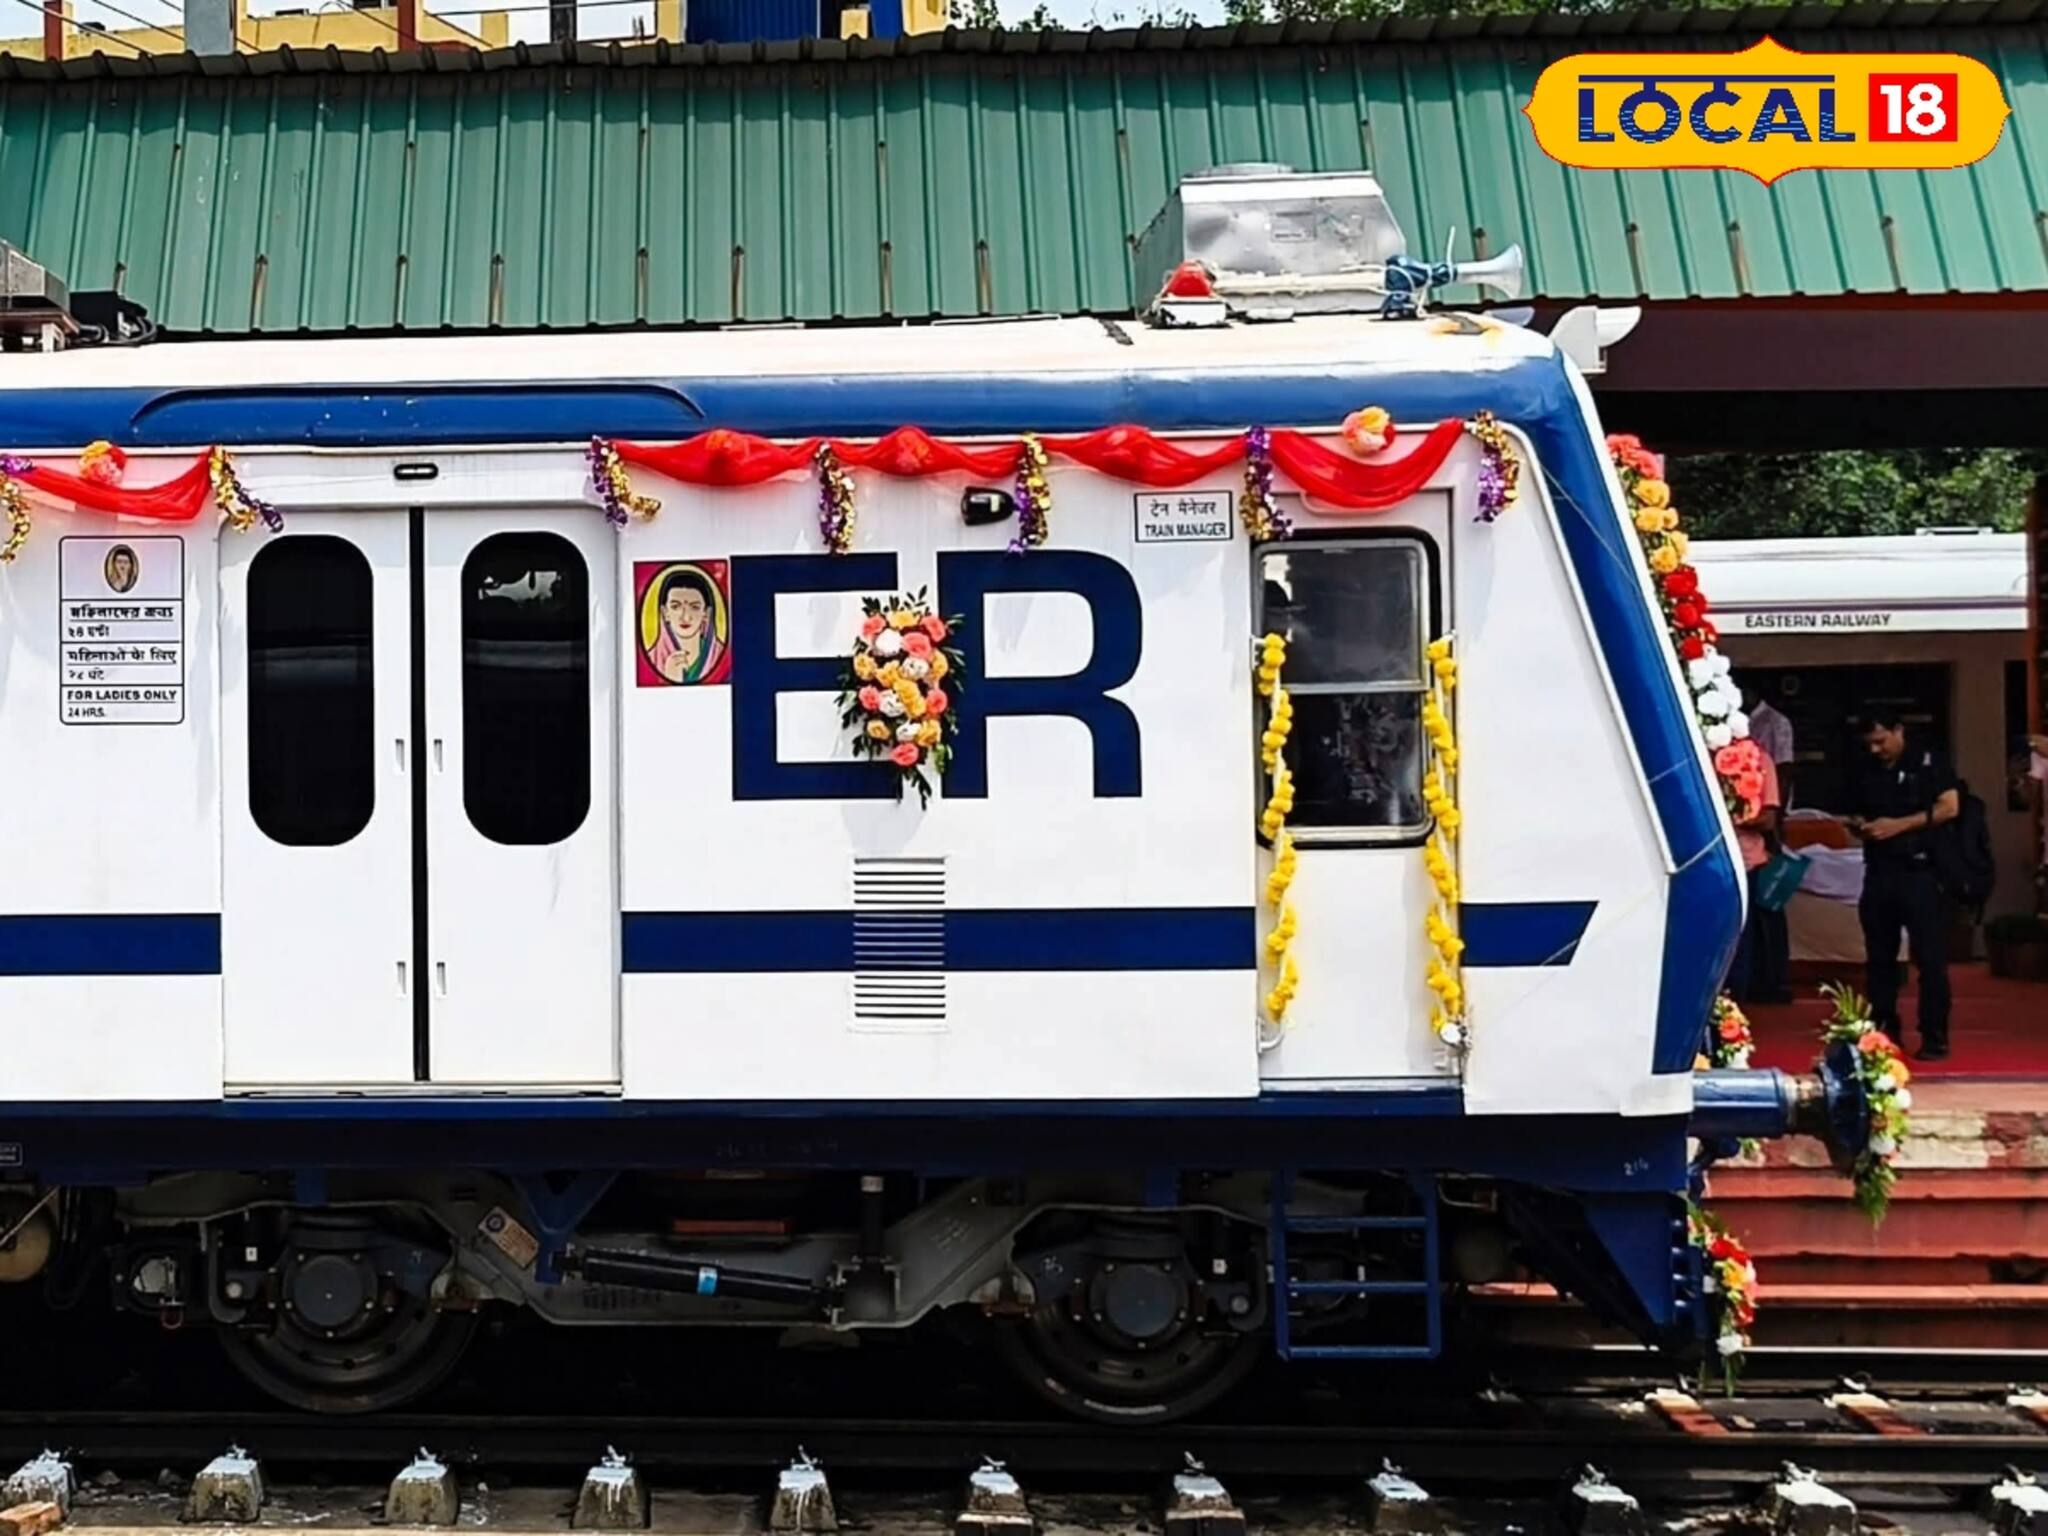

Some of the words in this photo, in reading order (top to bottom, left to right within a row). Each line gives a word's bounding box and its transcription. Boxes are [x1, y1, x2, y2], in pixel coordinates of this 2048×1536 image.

[1145, 523, 1174, 537] TRAIN
[1176, 521, 1226, 536] MANAGER
[1745, 614, 1816, 628] EASTERN
[1821, 613, 1891, 627] RAILWAY
[730, 549, 1142, 801] ER
[67, 690, 93, 700] FOR
[96, 690, 140, 700] LADIES
[143, 690, 177, 700] ONLY
[68, 707, 80, 717] 24
